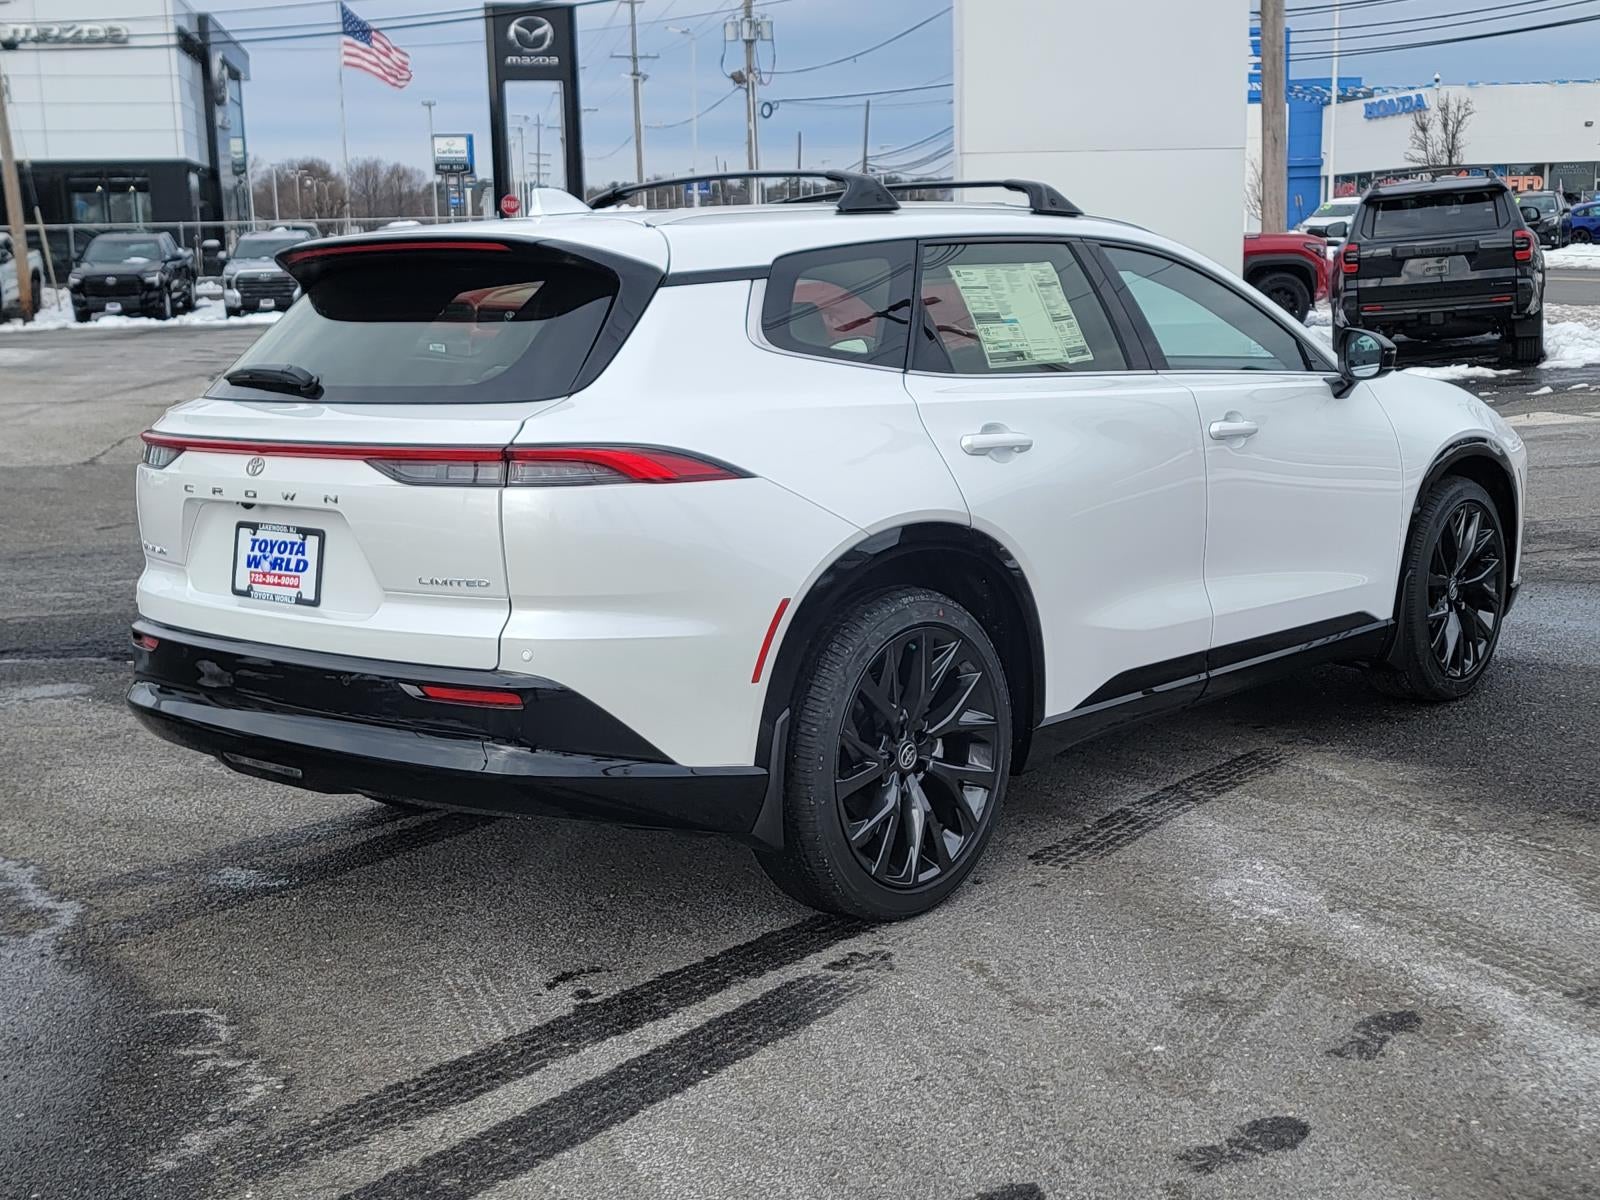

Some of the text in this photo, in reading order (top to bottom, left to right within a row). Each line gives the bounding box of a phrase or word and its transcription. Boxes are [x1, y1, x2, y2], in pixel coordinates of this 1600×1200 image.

[505, 55, 559, 65] mazda
[1363, 94, 1429, 119] HONDA
[503, 200, 519, 208] STOP
[184, 483, 339, 505] CROWN
[250, 538, 306, 556] TOYOTA
[250, 572, 300, 586] 732-364-9000
[418, 576, 491, 588] LIMITED
[250, 591, 296, 604] TOYOTA WORLD
